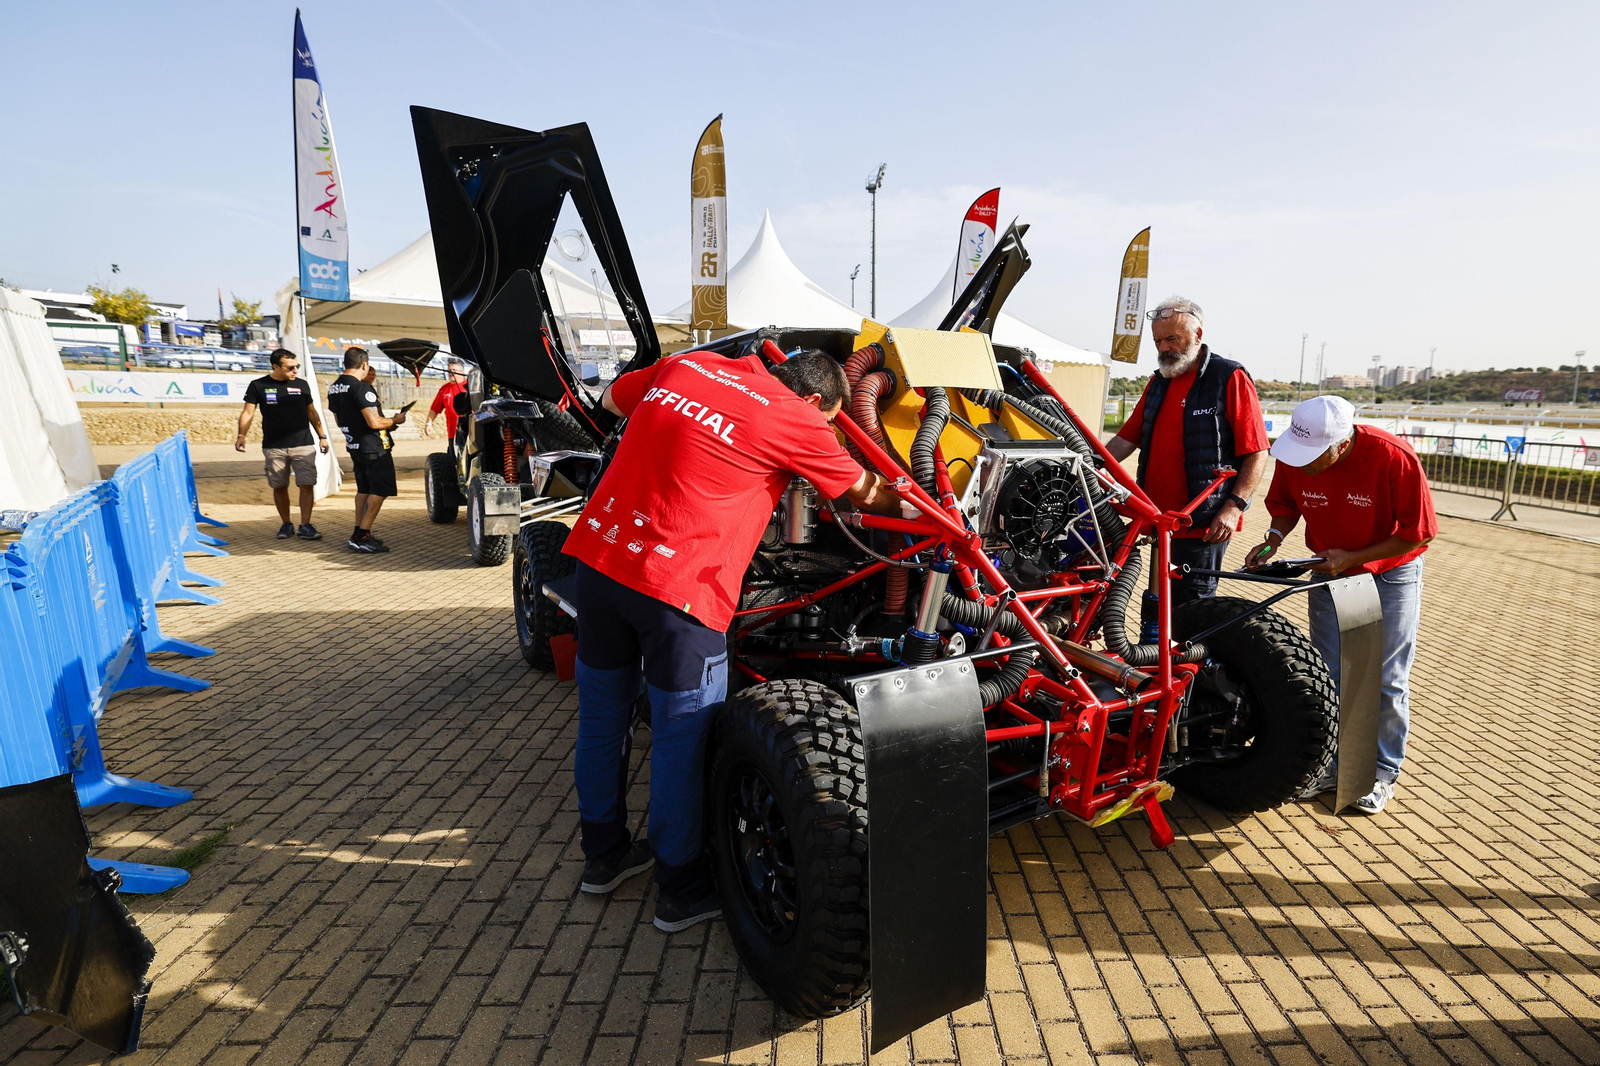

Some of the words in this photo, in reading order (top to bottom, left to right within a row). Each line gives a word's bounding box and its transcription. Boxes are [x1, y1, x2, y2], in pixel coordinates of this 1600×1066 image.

[309, 261, 340, 280] odc
[679, 359, 770, 407] andaluciarallyodc.com
[716, 369, 742, 380] www
[643, 387, 735, 445] OFFICIAL
